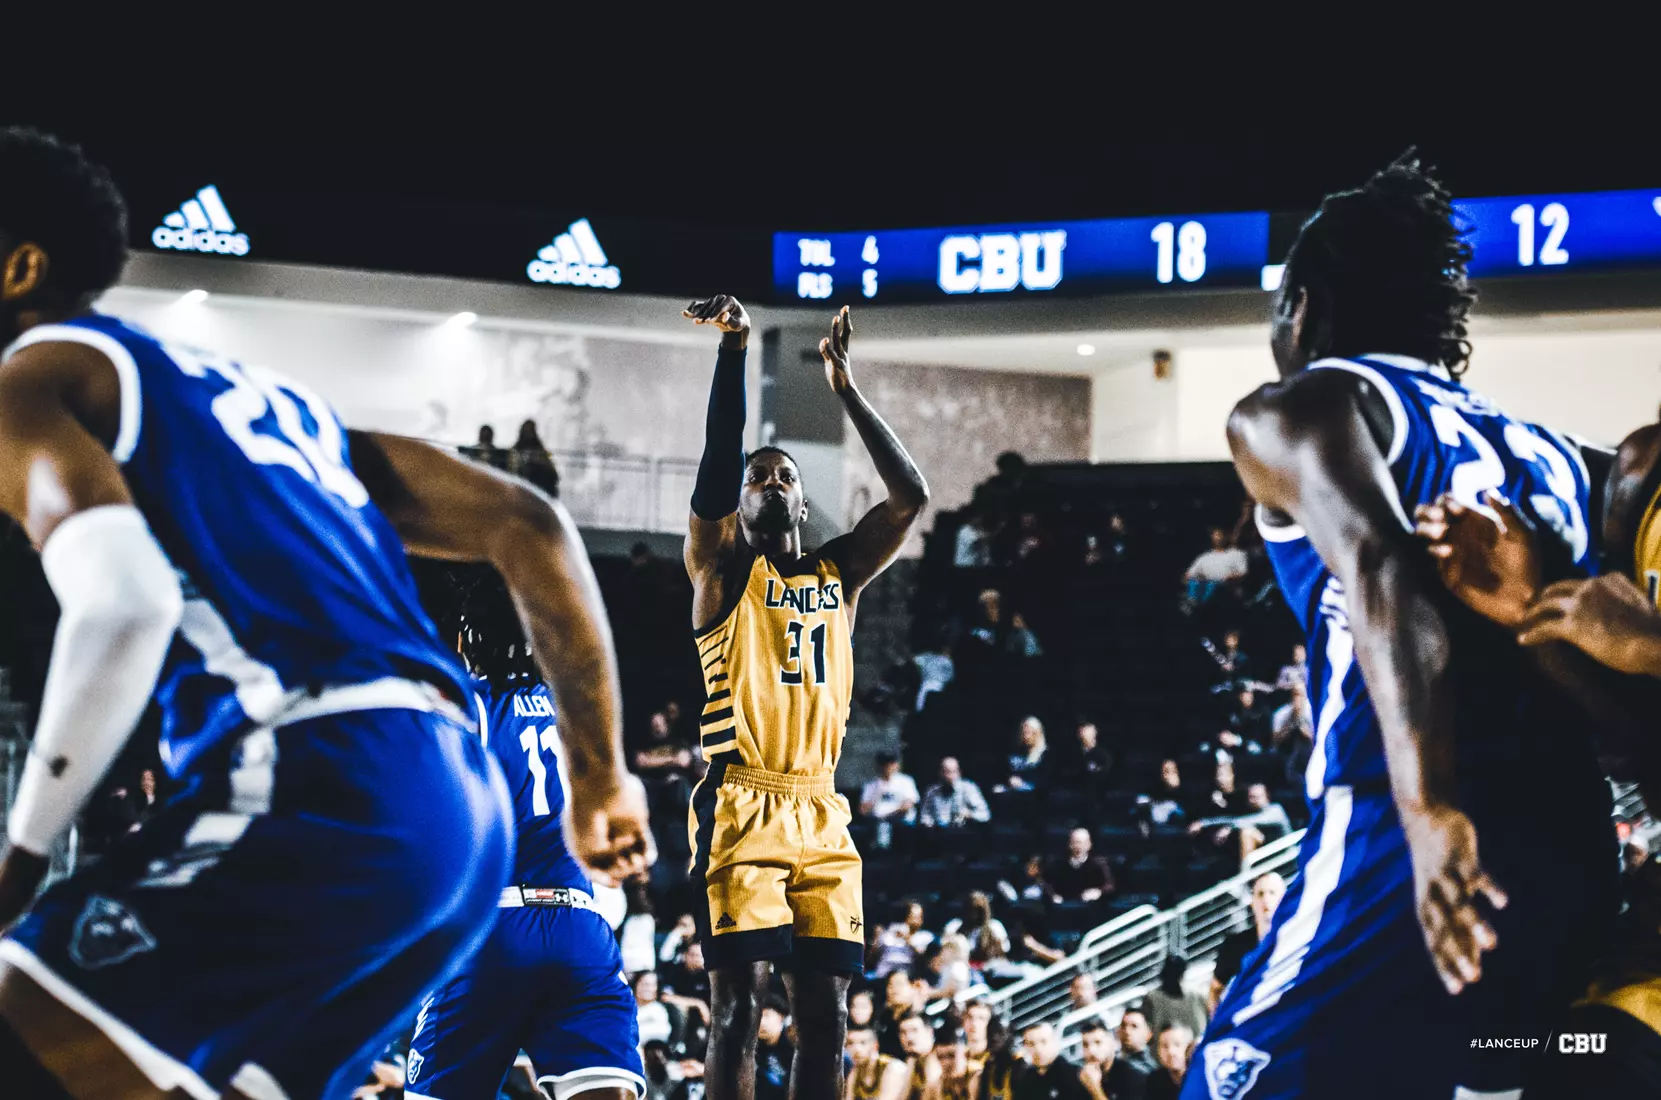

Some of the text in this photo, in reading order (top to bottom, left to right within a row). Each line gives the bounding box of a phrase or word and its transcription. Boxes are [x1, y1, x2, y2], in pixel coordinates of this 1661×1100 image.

[152, 226, 250, 256] adidas
[861, 235, 880, 265] 4
[937, 220, 1207, 294] CBU 18
[1511, 202, 1570, 267] 12
[526, 259, 621, 289] adidas
[862, 268, 878, 298] 5
[162, 342, 369, 508] 20
[1430, 404, 1588, 563] 23
[781, 620, 826, 685] 31
[514, 693, 556, 717] ALLEN
